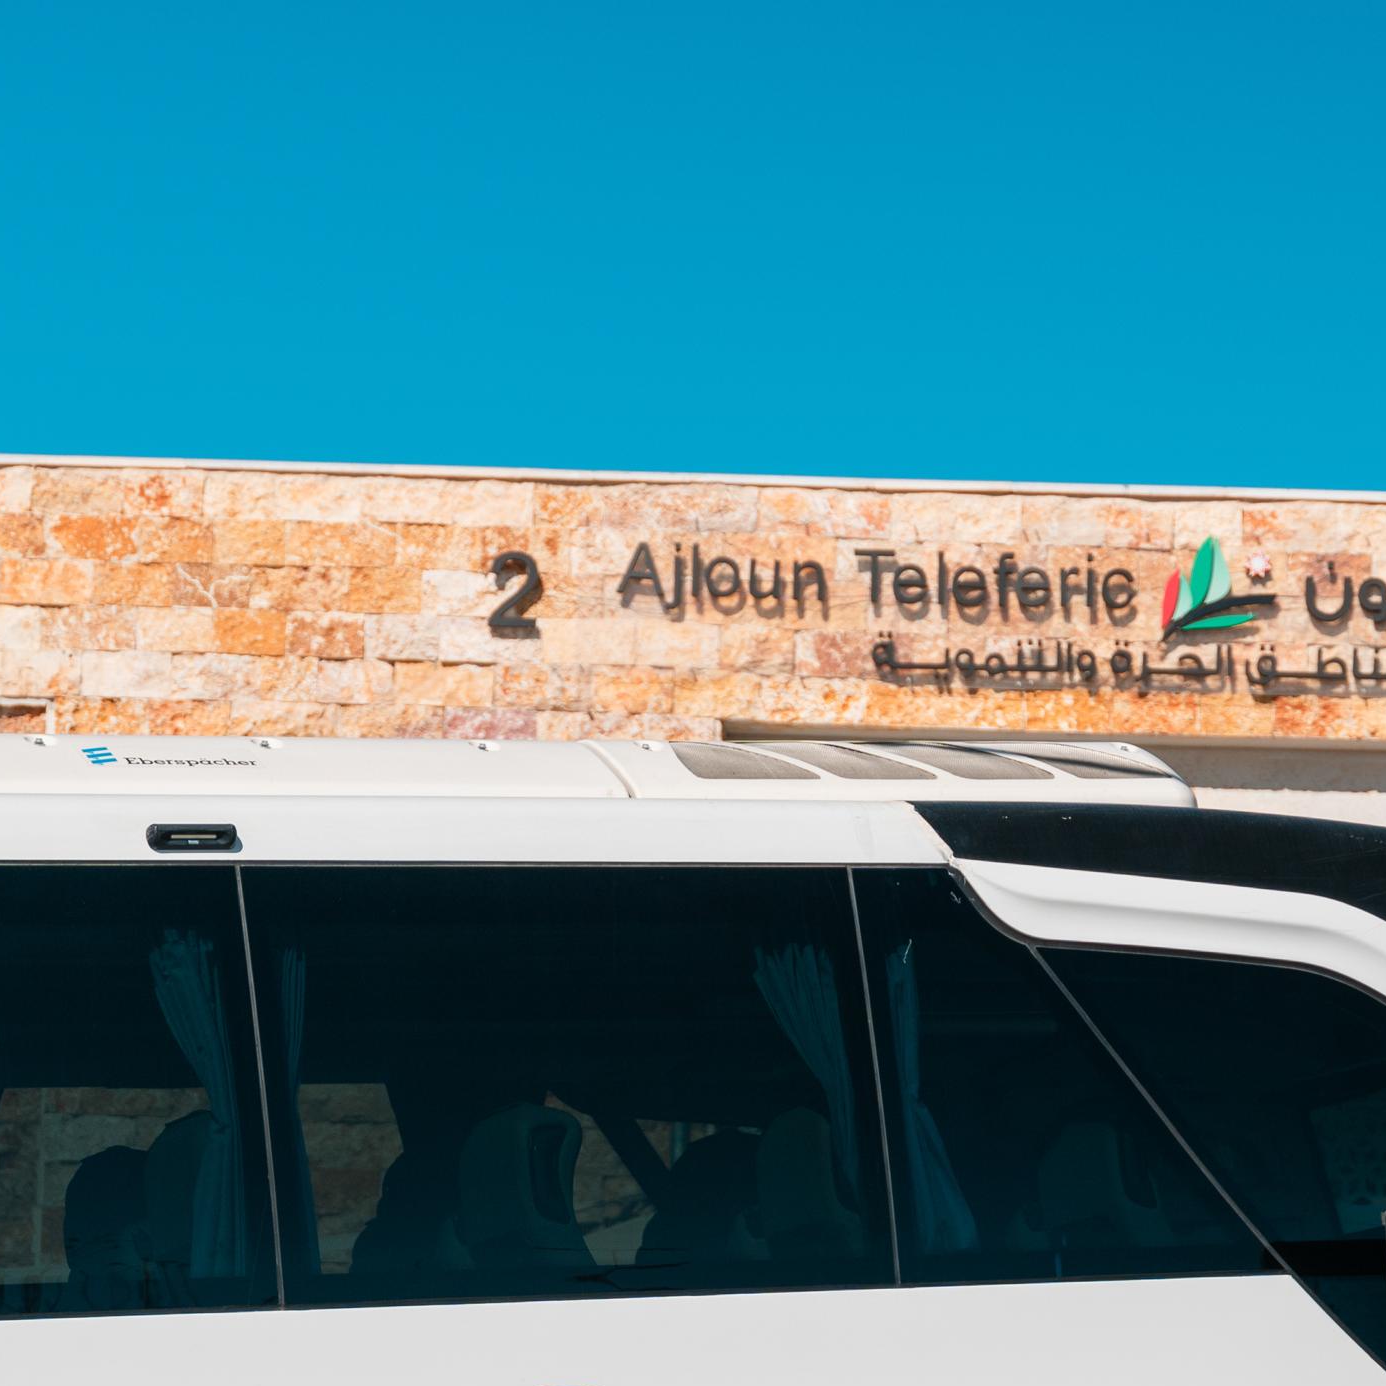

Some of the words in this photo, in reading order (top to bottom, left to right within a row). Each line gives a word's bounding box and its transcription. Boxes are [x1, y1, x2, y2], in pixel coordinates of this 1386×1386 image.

[488, 550, 543, 629] 2
[617, 541, 827, 611] Ajloun
[854, 548, 1136, 609] Teleferic
[873, 631, 1097, 682] والتنموية
[1110, 639, 1235, 682] الحرة
[124, 756, 257, 768] Eberspächer
